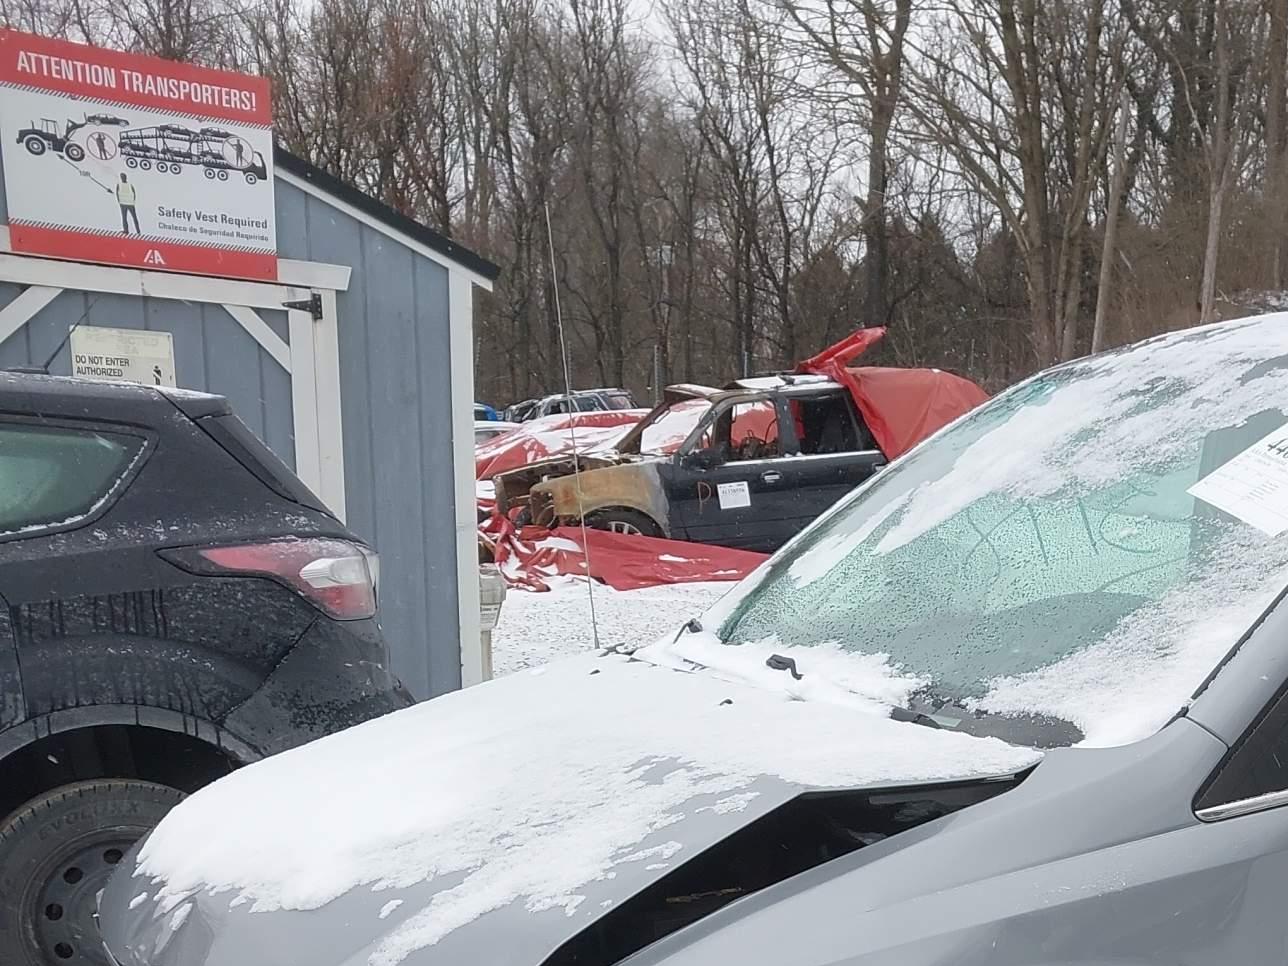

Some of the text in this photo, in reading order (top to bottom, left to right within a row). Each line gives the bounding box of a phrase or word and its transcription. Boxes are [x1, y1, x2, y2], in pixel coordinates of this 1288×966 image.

[16, 50, 257, 112] ATTENTION TRANSPORTERS!
[158, 206, 268, 229] Safety Vest Required
[158, 222, 187, 232] Chaleco
[199, 227, 235, 237] Seguridad
[75, 354, 130, 367] DO NOT ENTER
[76, 366, 123, 377] AUTHORIZED
